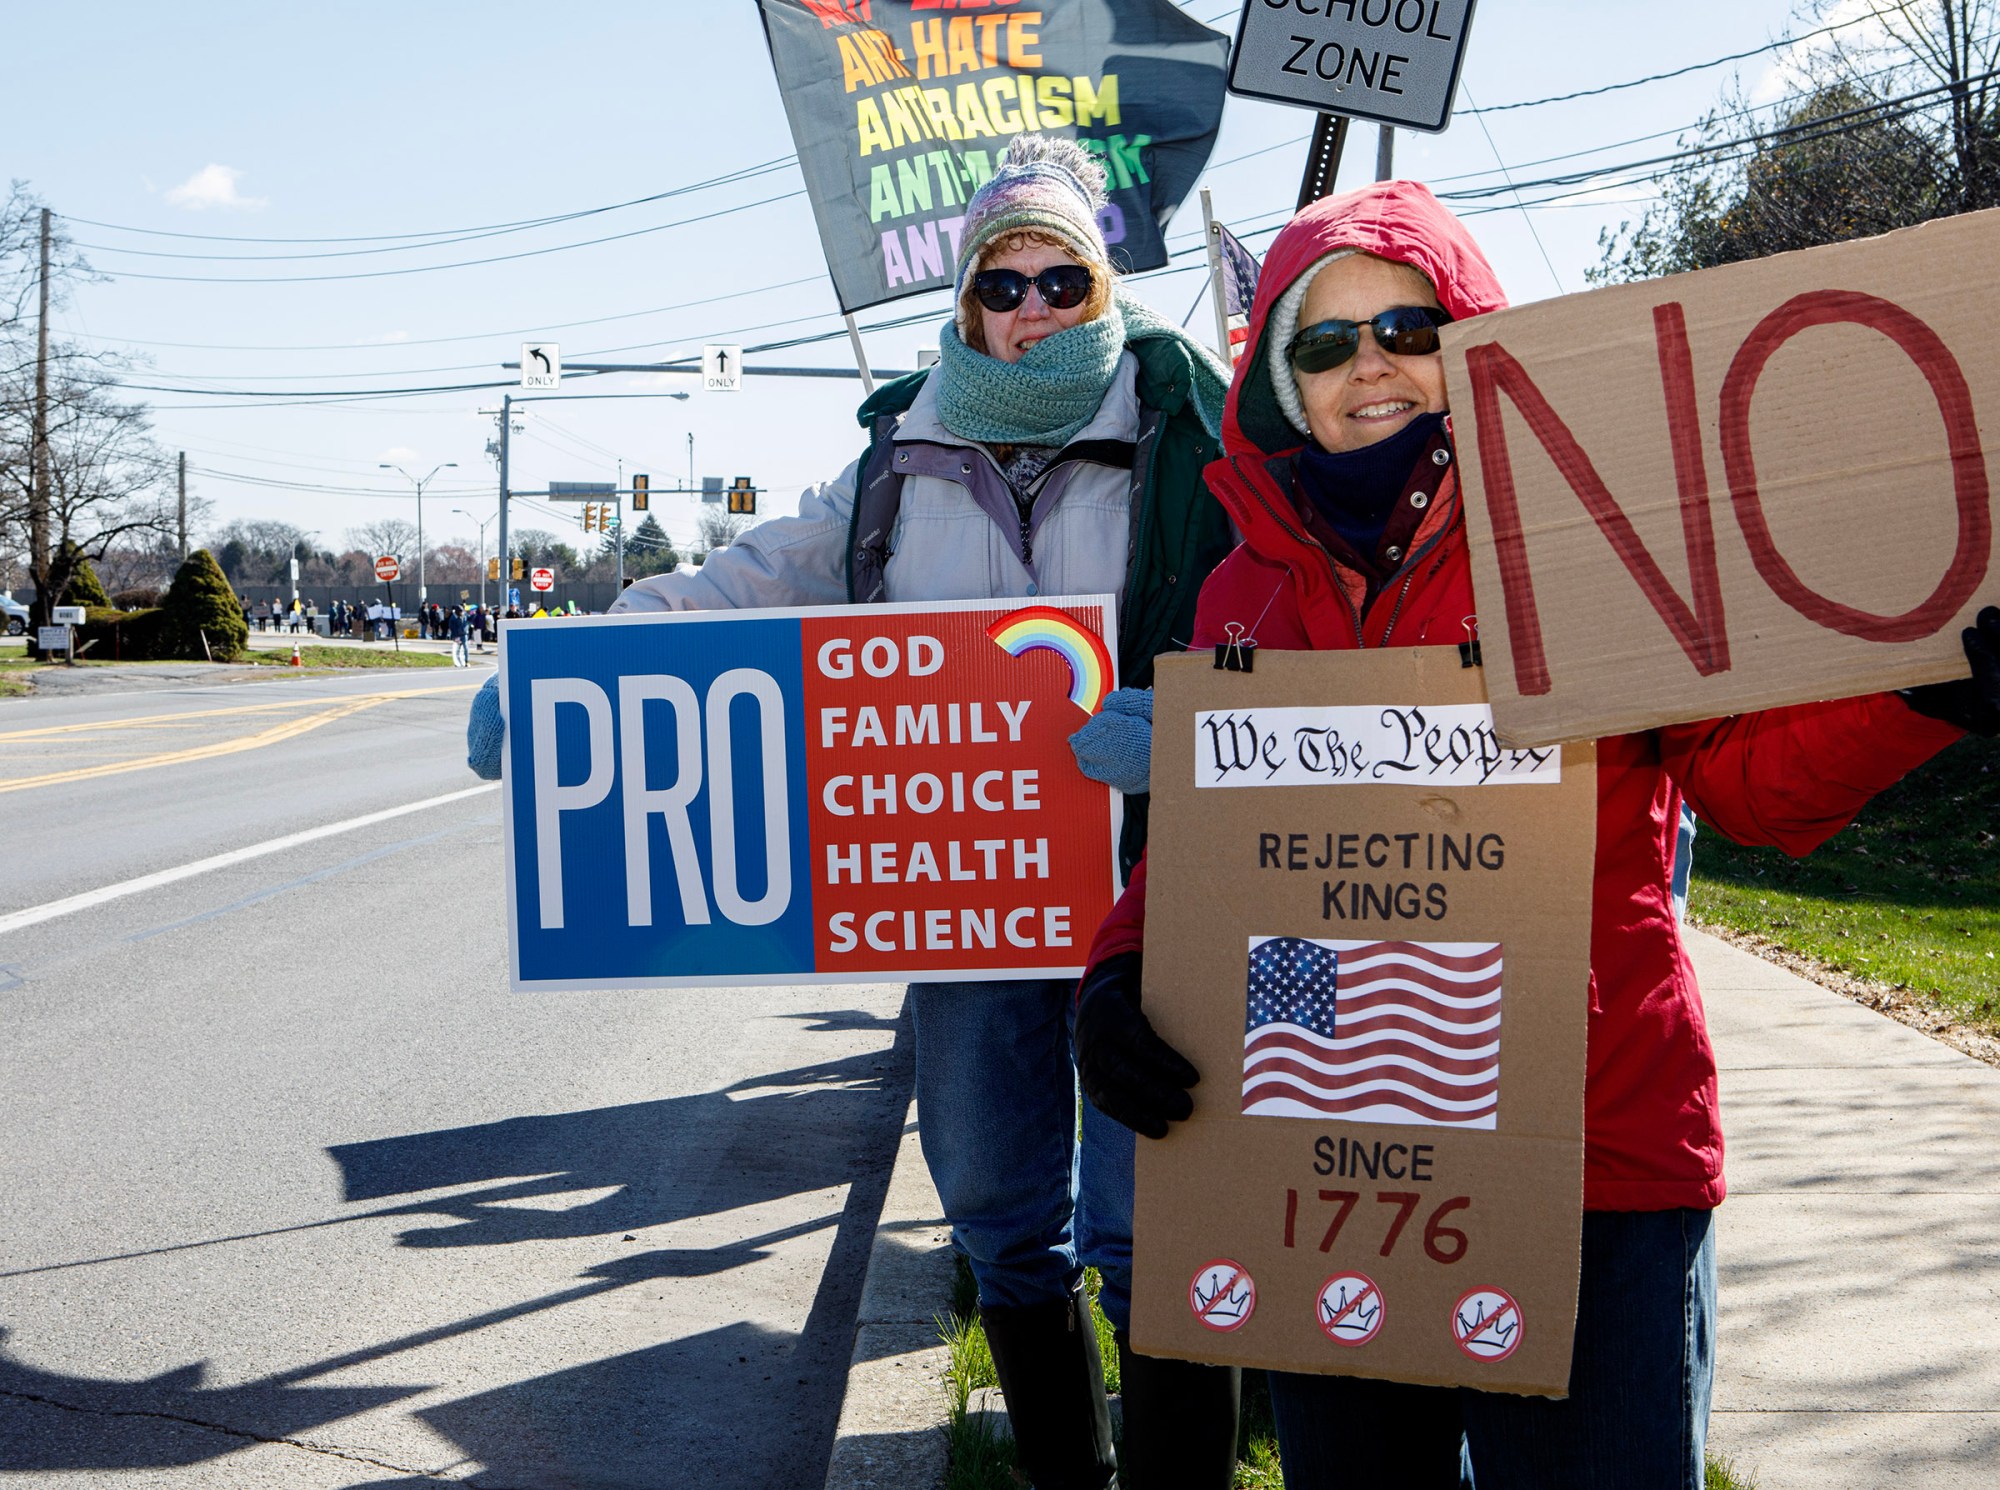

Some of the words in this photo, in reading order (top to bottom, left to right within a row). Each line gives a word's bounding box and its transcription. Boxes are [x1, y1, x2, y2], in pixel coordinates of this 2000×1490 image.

[1262, 0, 1451, 41] HOOL
[1281, 35, 1410, 95] ZONE
[527, 376, 555, 386] ONLY
[708, 378, 736, 388] ONLY
[1465, 289, 1992, 696] NO
[817, 635, 946, 680] GOD
[821, 700, 1033, 749] FAMILY
[1201, 713, 1287, 783] We
[1294, 726, 1370, 779] The
[1372, 705, 1554, 785] Peop
[531, 667, 792, 931] PRO
[822, 768, 1043, 817] CHOICE
[826, 837, 1051, 885] HEALTH
[1259, 832, 1506, 873] REJECTING
[1322, 879, 1448, 922] KINGS
[829, 906, 1074, 953] SCIENCE
[1312, 1135, 1435, 1182] SINCE
[1283, 1188, 1471, 1265] 1776
